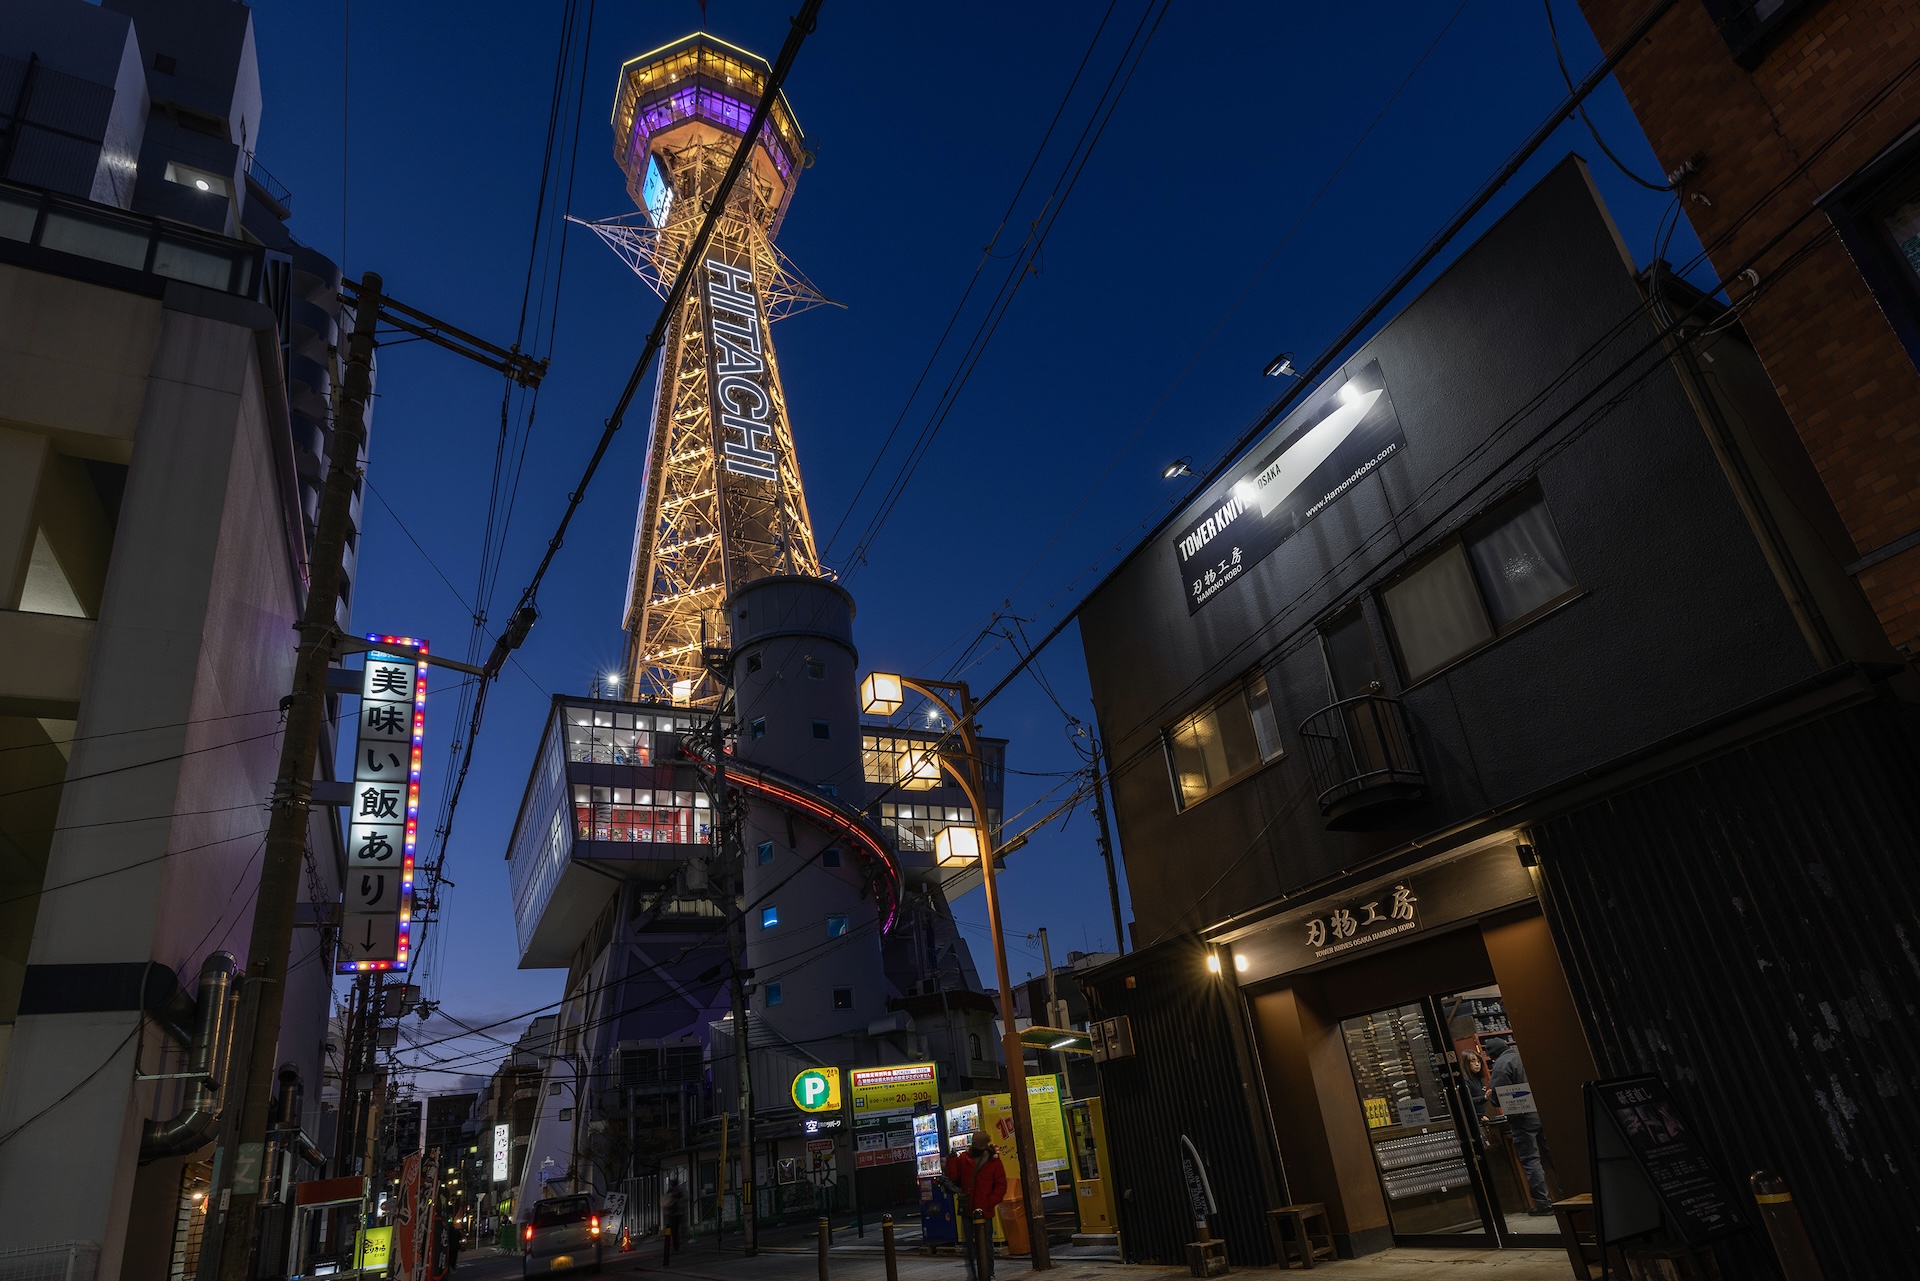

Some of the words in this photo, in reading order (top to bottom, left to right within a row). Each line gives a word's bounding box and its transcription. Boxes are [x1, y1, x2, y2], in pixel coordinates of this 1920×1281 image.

[707, 259, 777, 481] HITACHI
[1257, 464, 1281, 490] OSAKA
[1305, 443, 1397, 518] www.HamonoKobo.com
[1179, 518, 1217, 561] TOWER
[1192, 546, 1243, 596] 刃物工房
[1197, 579, 1224, 604] HAMONO
[1224, 564, 1242, 582] KOBO
[358, 666, 409, 906] 美味い飯あり
[1305, 885, 1418, 947] 刃物工房
[1315, 947, 1334, 958] TOWER
[1334, 941, 1353, 953] KNIVES
[1353, 936, 1372, 946] OSAKA
[1372, 927, 1398, 941] HAMONO
[1398, 922, 1415, 933] KOBO
[805, 1078, 825, 1105] P
[805, 1120, 818, 1133] 空
